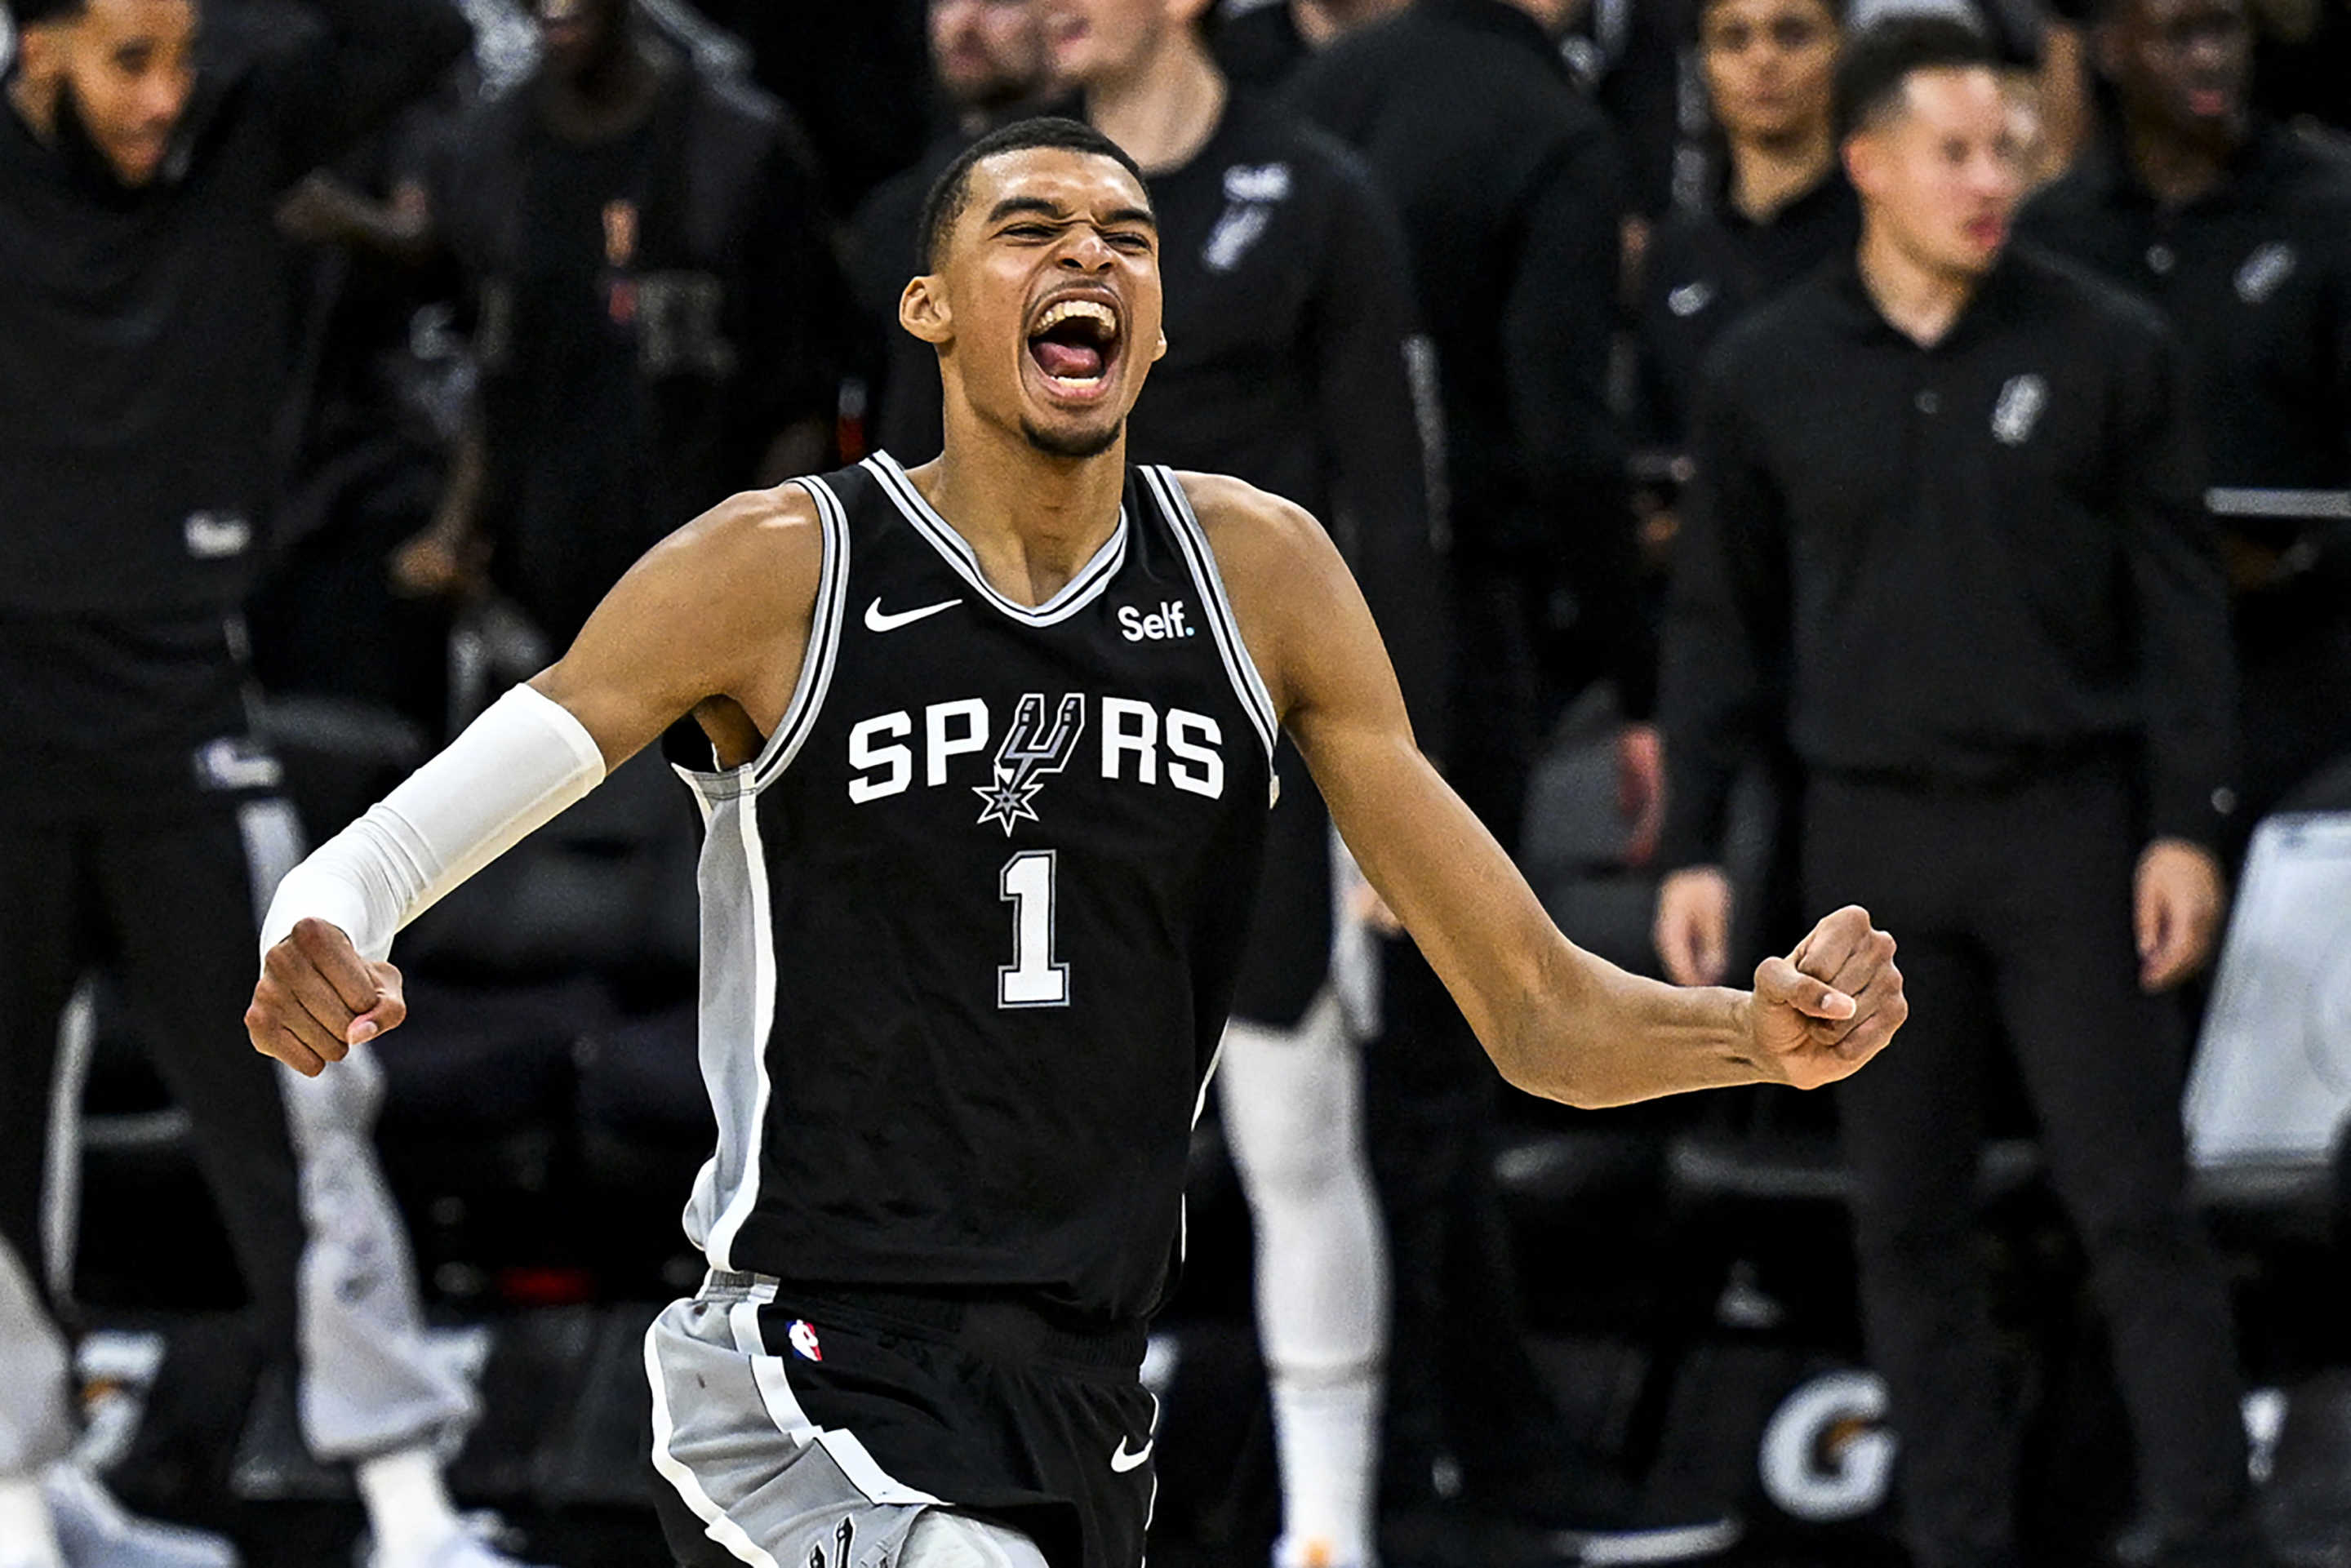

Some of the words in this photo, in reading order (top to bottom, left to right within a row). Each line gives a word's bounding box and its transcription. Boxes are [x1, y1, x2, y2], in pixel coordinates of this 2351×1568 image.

[1117, 599, 1196, 642] Self.
[847, 692, 1225, 838] SPURS
[997, 847, 1071, 1010] 1
